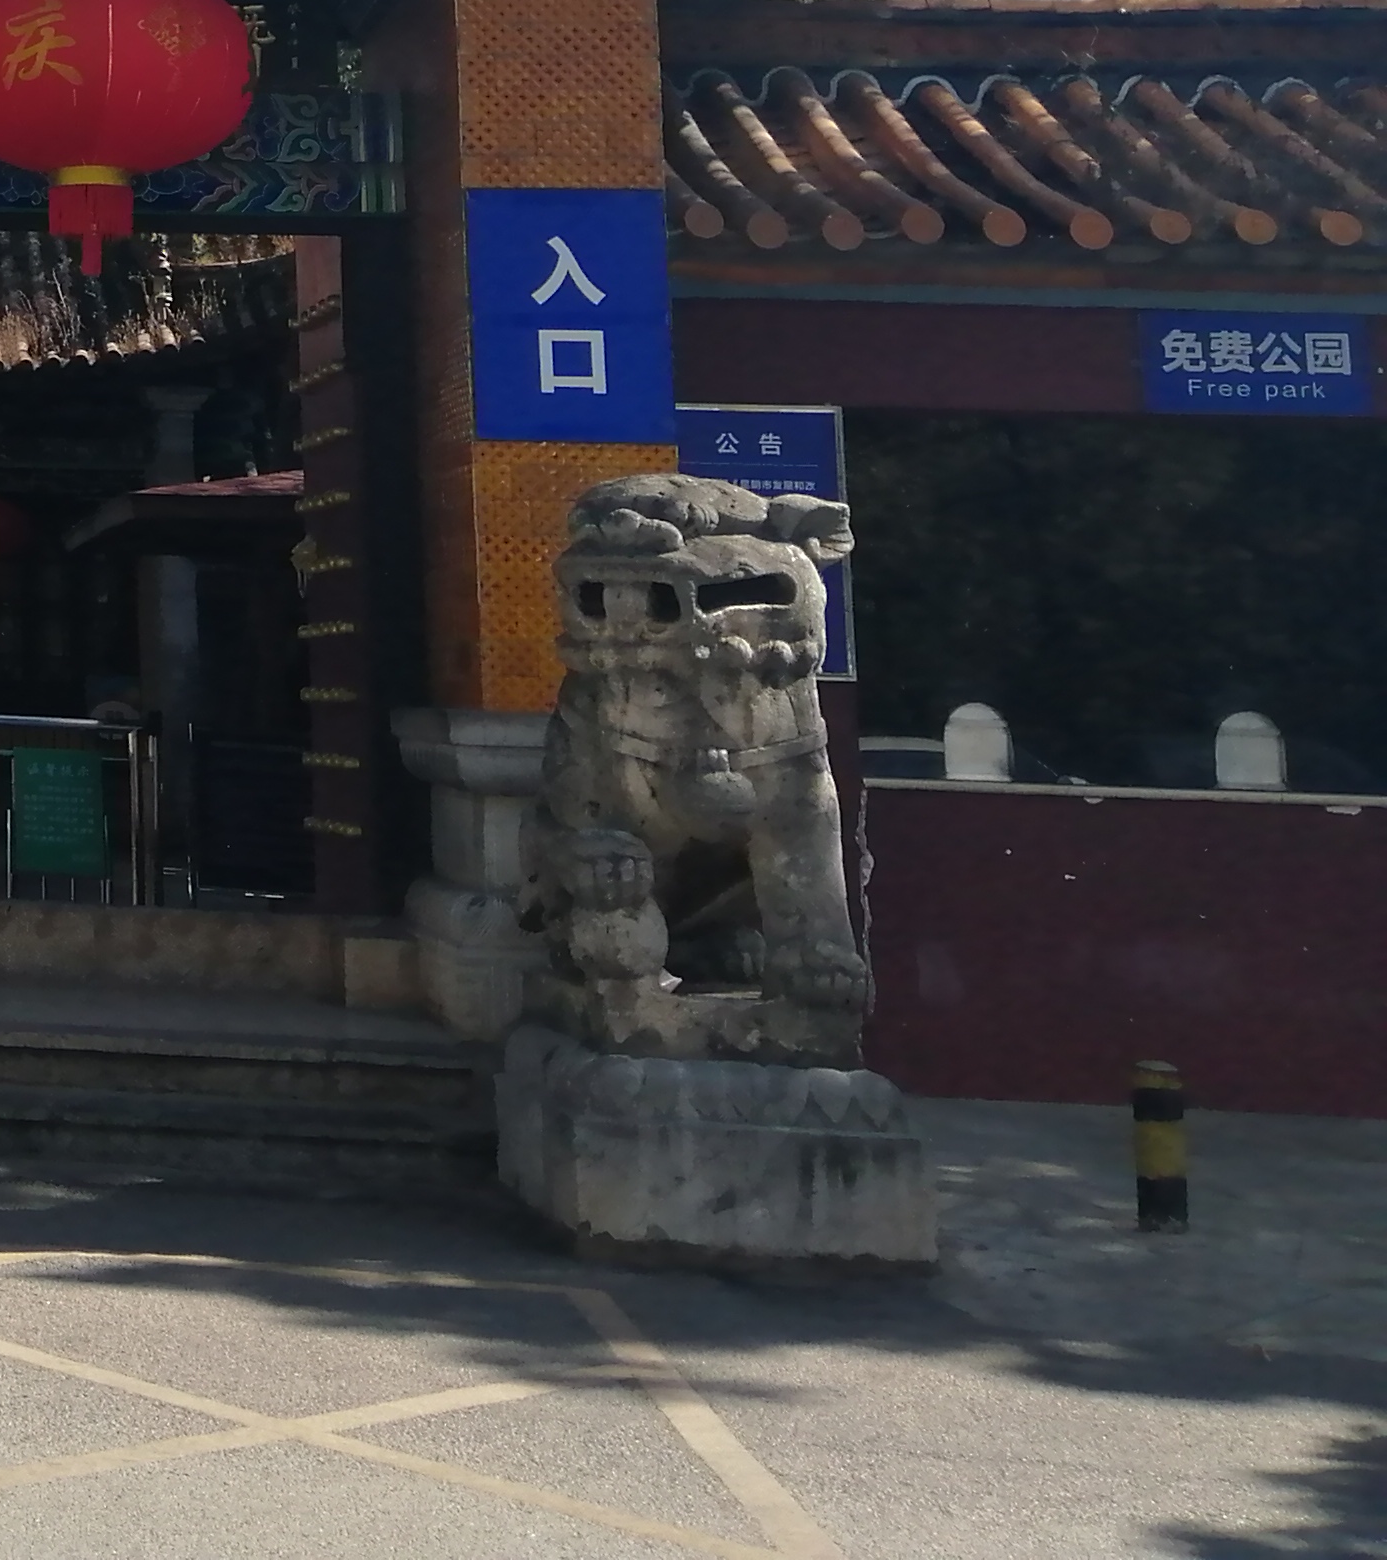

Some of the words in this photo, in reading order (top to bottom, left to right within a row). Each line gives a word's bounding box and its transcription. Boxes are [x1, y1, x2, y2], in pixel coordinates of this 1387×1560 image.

[531, 236, 607, 394] 入口
[1161, 329, 1352, 376] 免费公园
[1187, 379, 1251, 397] Free
[1265, 382, 1326, 401] park
[715, 432, 784, 456] 公告
